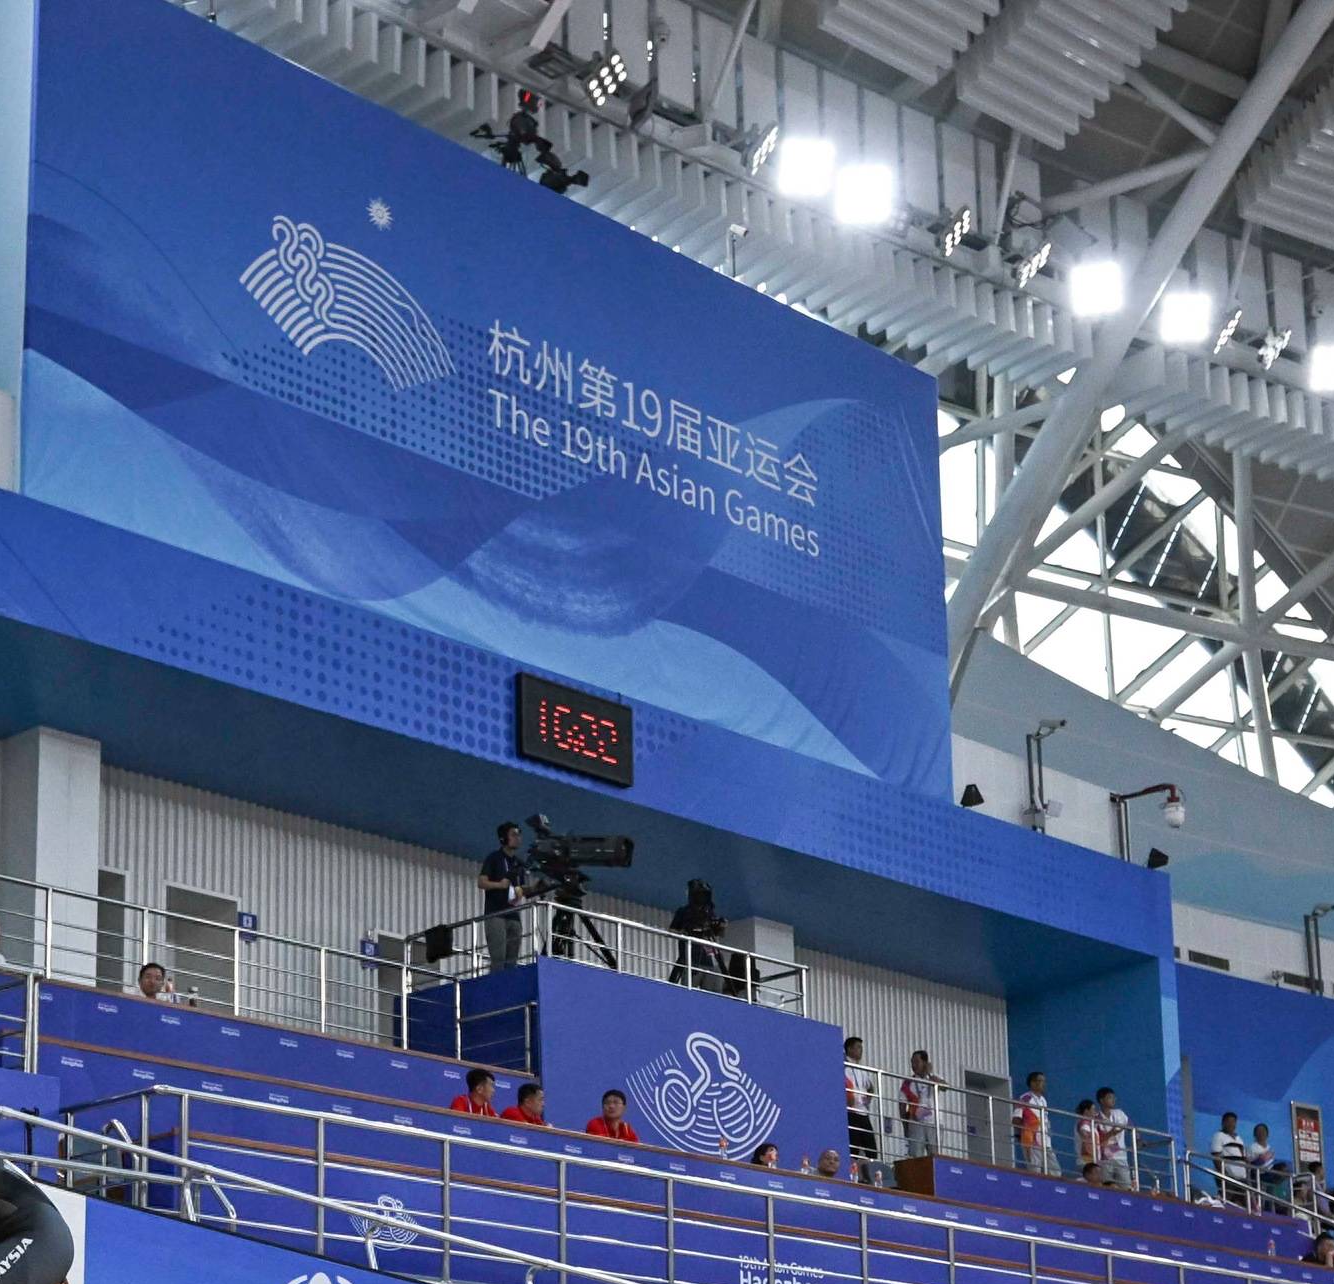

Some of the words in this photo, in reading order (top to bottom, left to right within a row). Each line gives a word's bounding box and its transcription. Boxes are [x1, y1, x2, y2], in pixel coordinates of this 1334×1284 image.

[488, 319, 819, 507] 杭州第19届亚运会
[488, 388, 550, 448] The
[561, 420, 627, 479] 19th
[636, 449, 715, 514] Asian
[725, 490, 821, 557] Games
